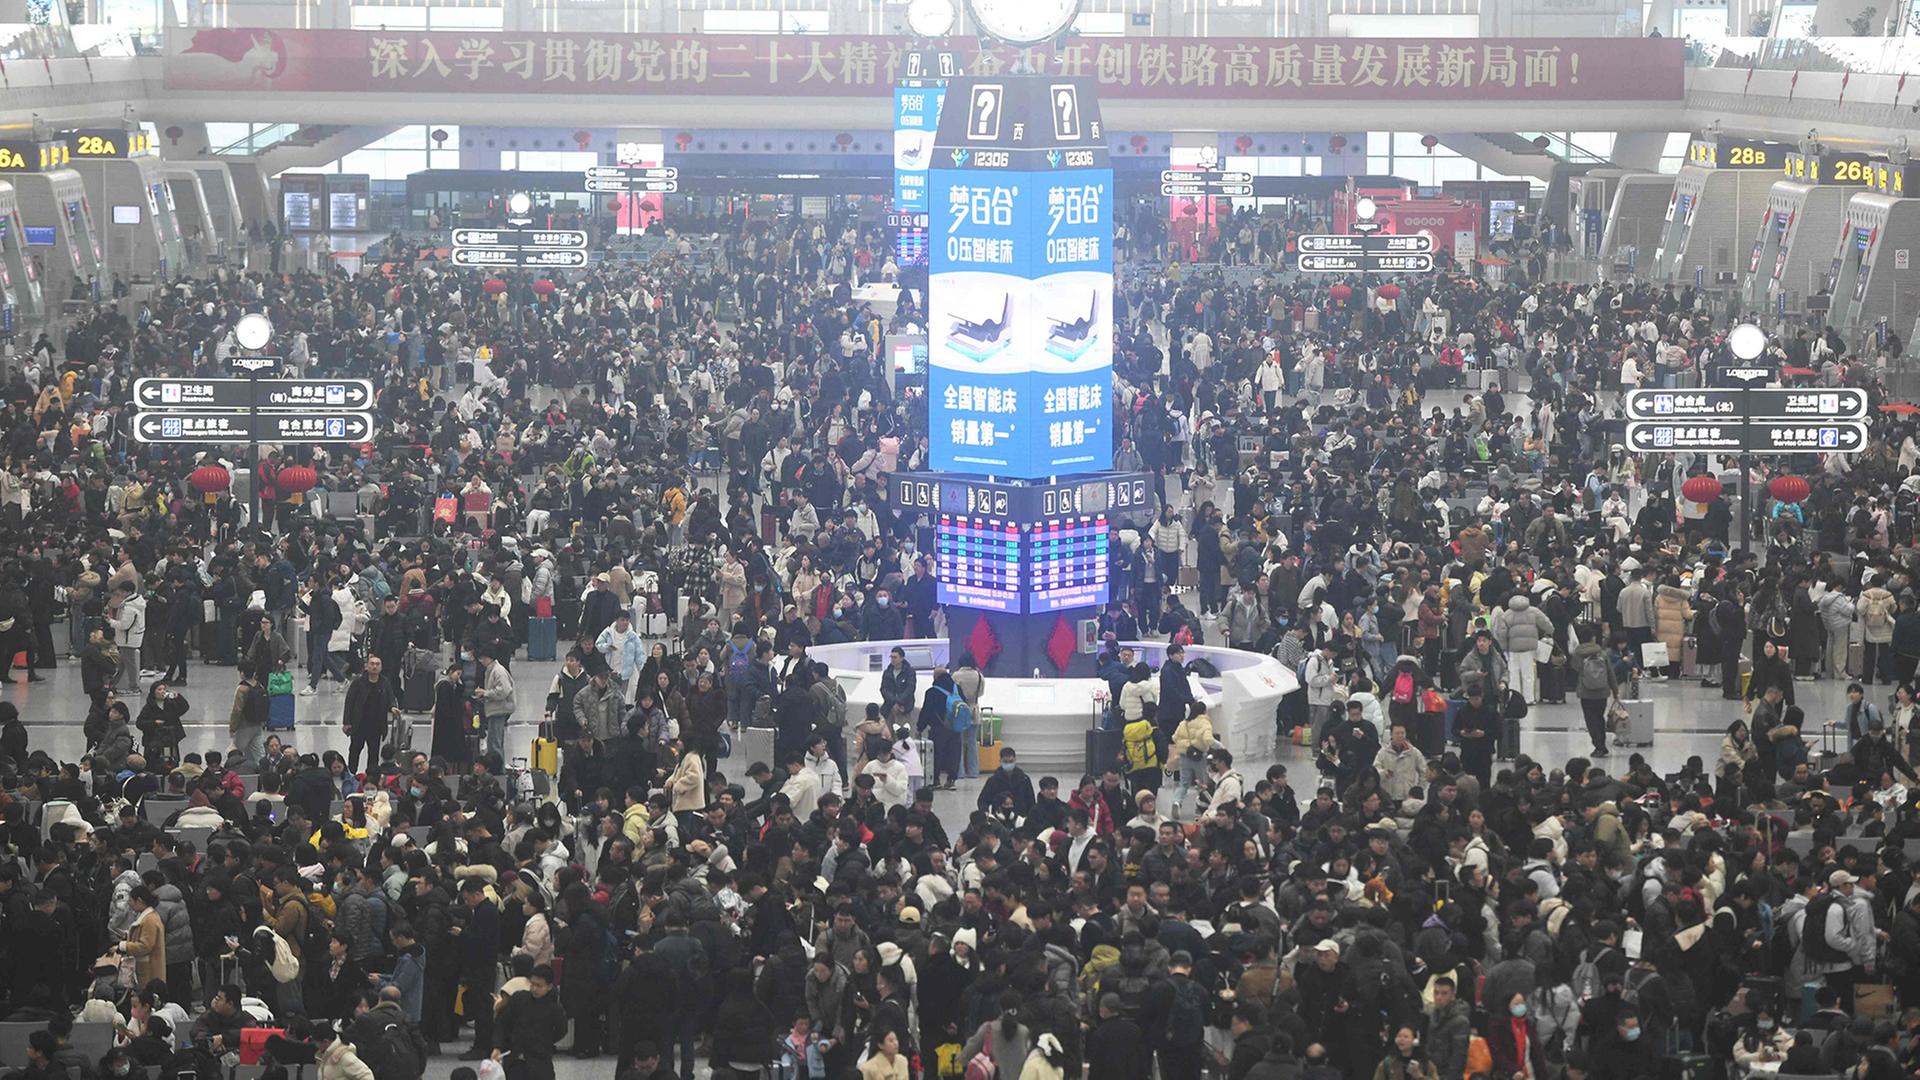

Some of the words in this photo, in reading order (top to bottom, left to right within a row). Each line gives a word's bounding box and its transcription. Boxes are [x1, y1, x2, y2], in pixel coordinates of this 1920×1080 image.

[1013, 123, 1024, 140] 西
[1090, 121, 1100, 139] 西
[77, 137, 116, 154] 28A
[974, 151, 1009, 167] 12306
[1065, 151, 1094, 166] 12306
[1730, 147, 1766, 165] 28B
[1834, 161, 1873, 180] 26B
[948, 185, 1013, 234] 梦百合
[1047, 184, 1100, 236] 梦百合
[947, 236, 1013, 264] 0压智能床
[1046, 236, 1100, 264] 0压智能床
[182, 385, 214, 396] 卫生间
[944, 384, 1017, 414] 全国智能床
[1044, 383, 1102, 413] 全国智能床
[1786, 395, 1818, 406] 卫生间
[951, 419, 1010, 446] 销量第一
[1049, 420, 1097, 448] 销量第一
